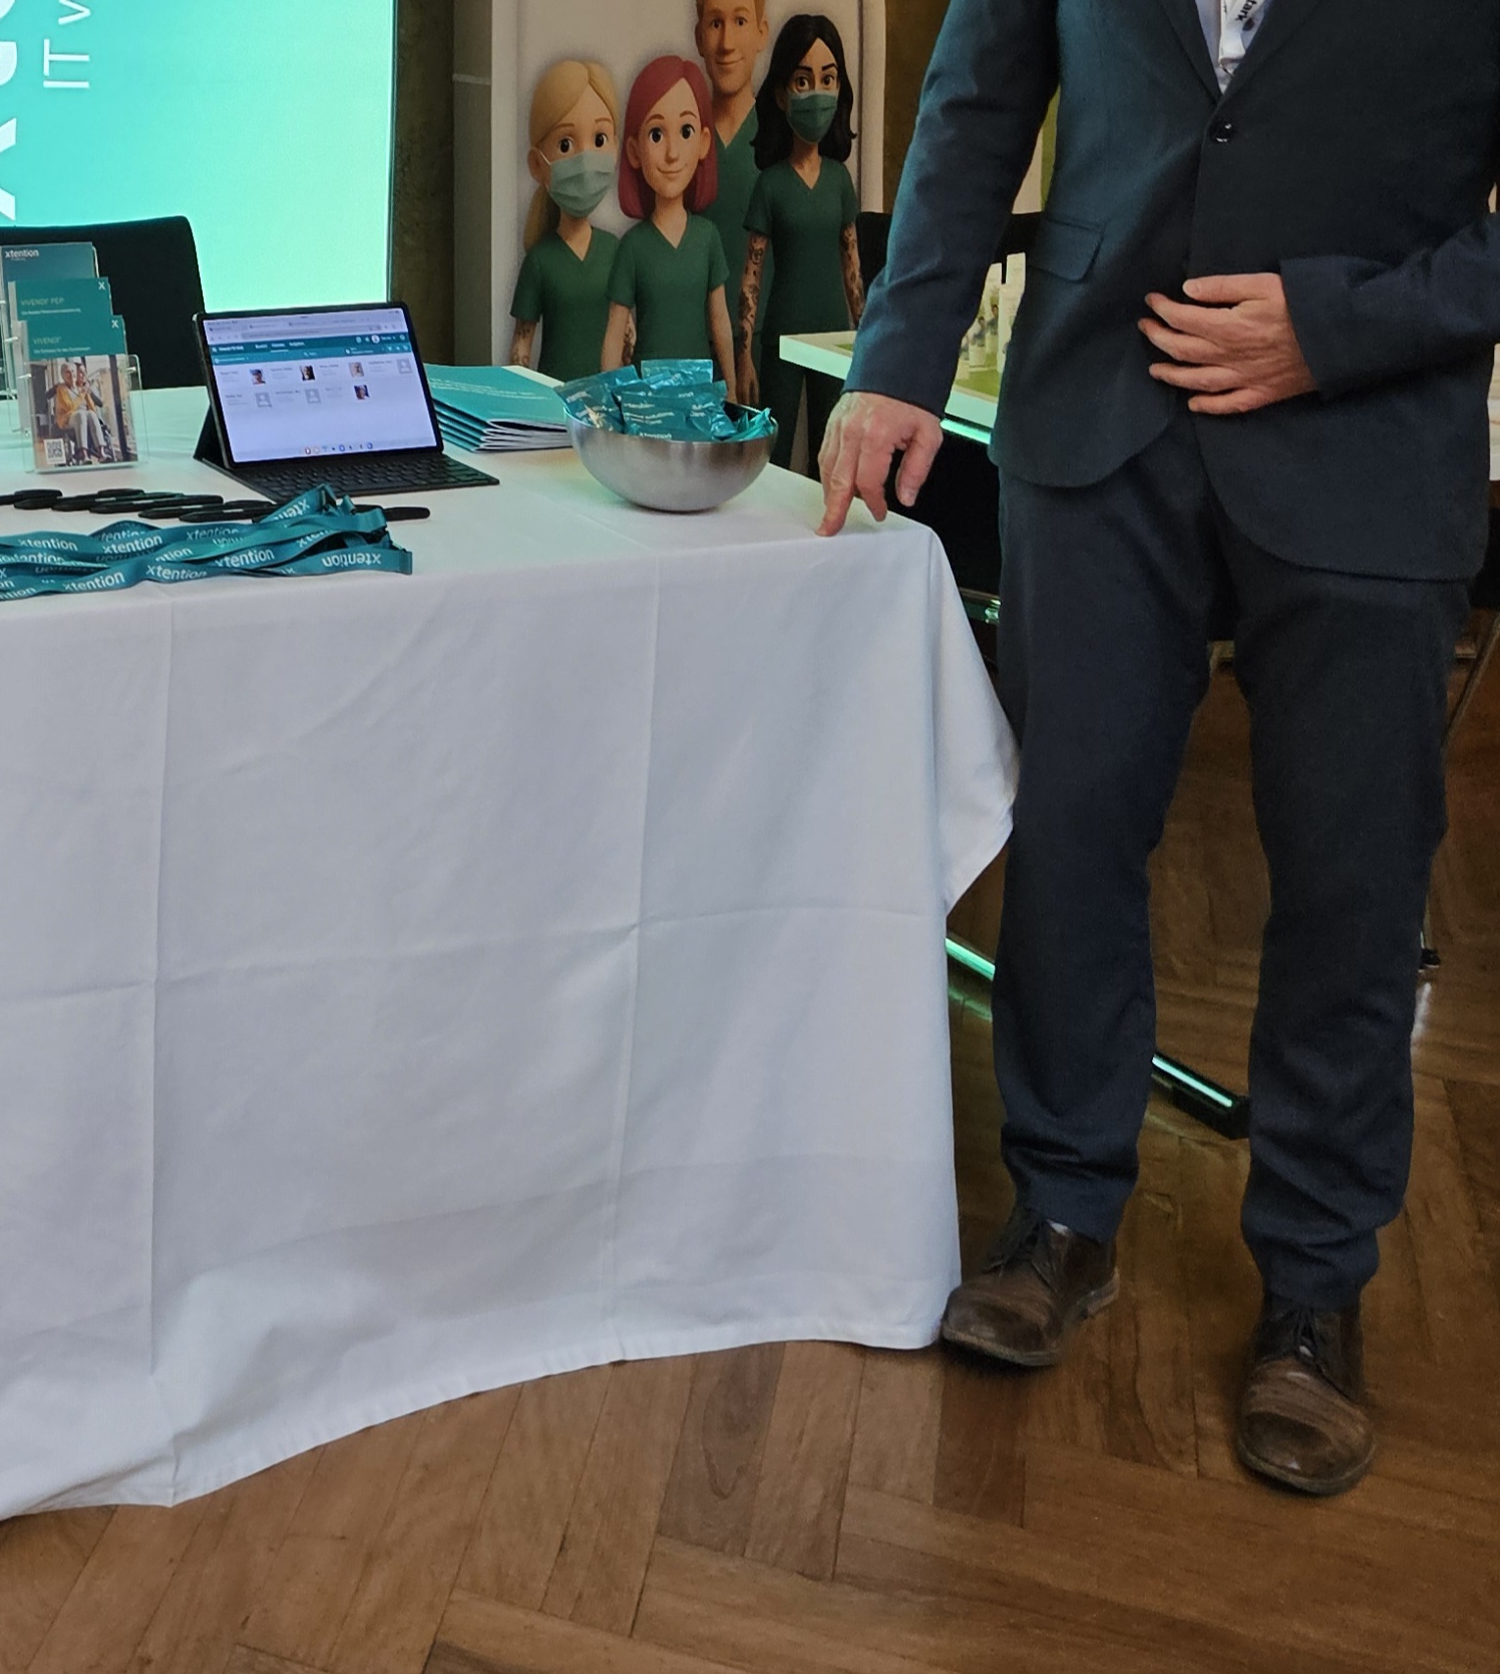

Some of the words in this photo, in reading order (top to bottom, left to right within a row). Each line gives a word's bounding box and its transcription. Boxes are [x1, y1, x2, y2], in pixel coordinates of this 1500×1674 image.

[43, 37, 90, 89] IT
[18, 538, 79, 552] xtention
[103, 534, 164, 555] xtention
[321, 552, 382, 567] xtention
[62, 569, 126, 592] xtention
